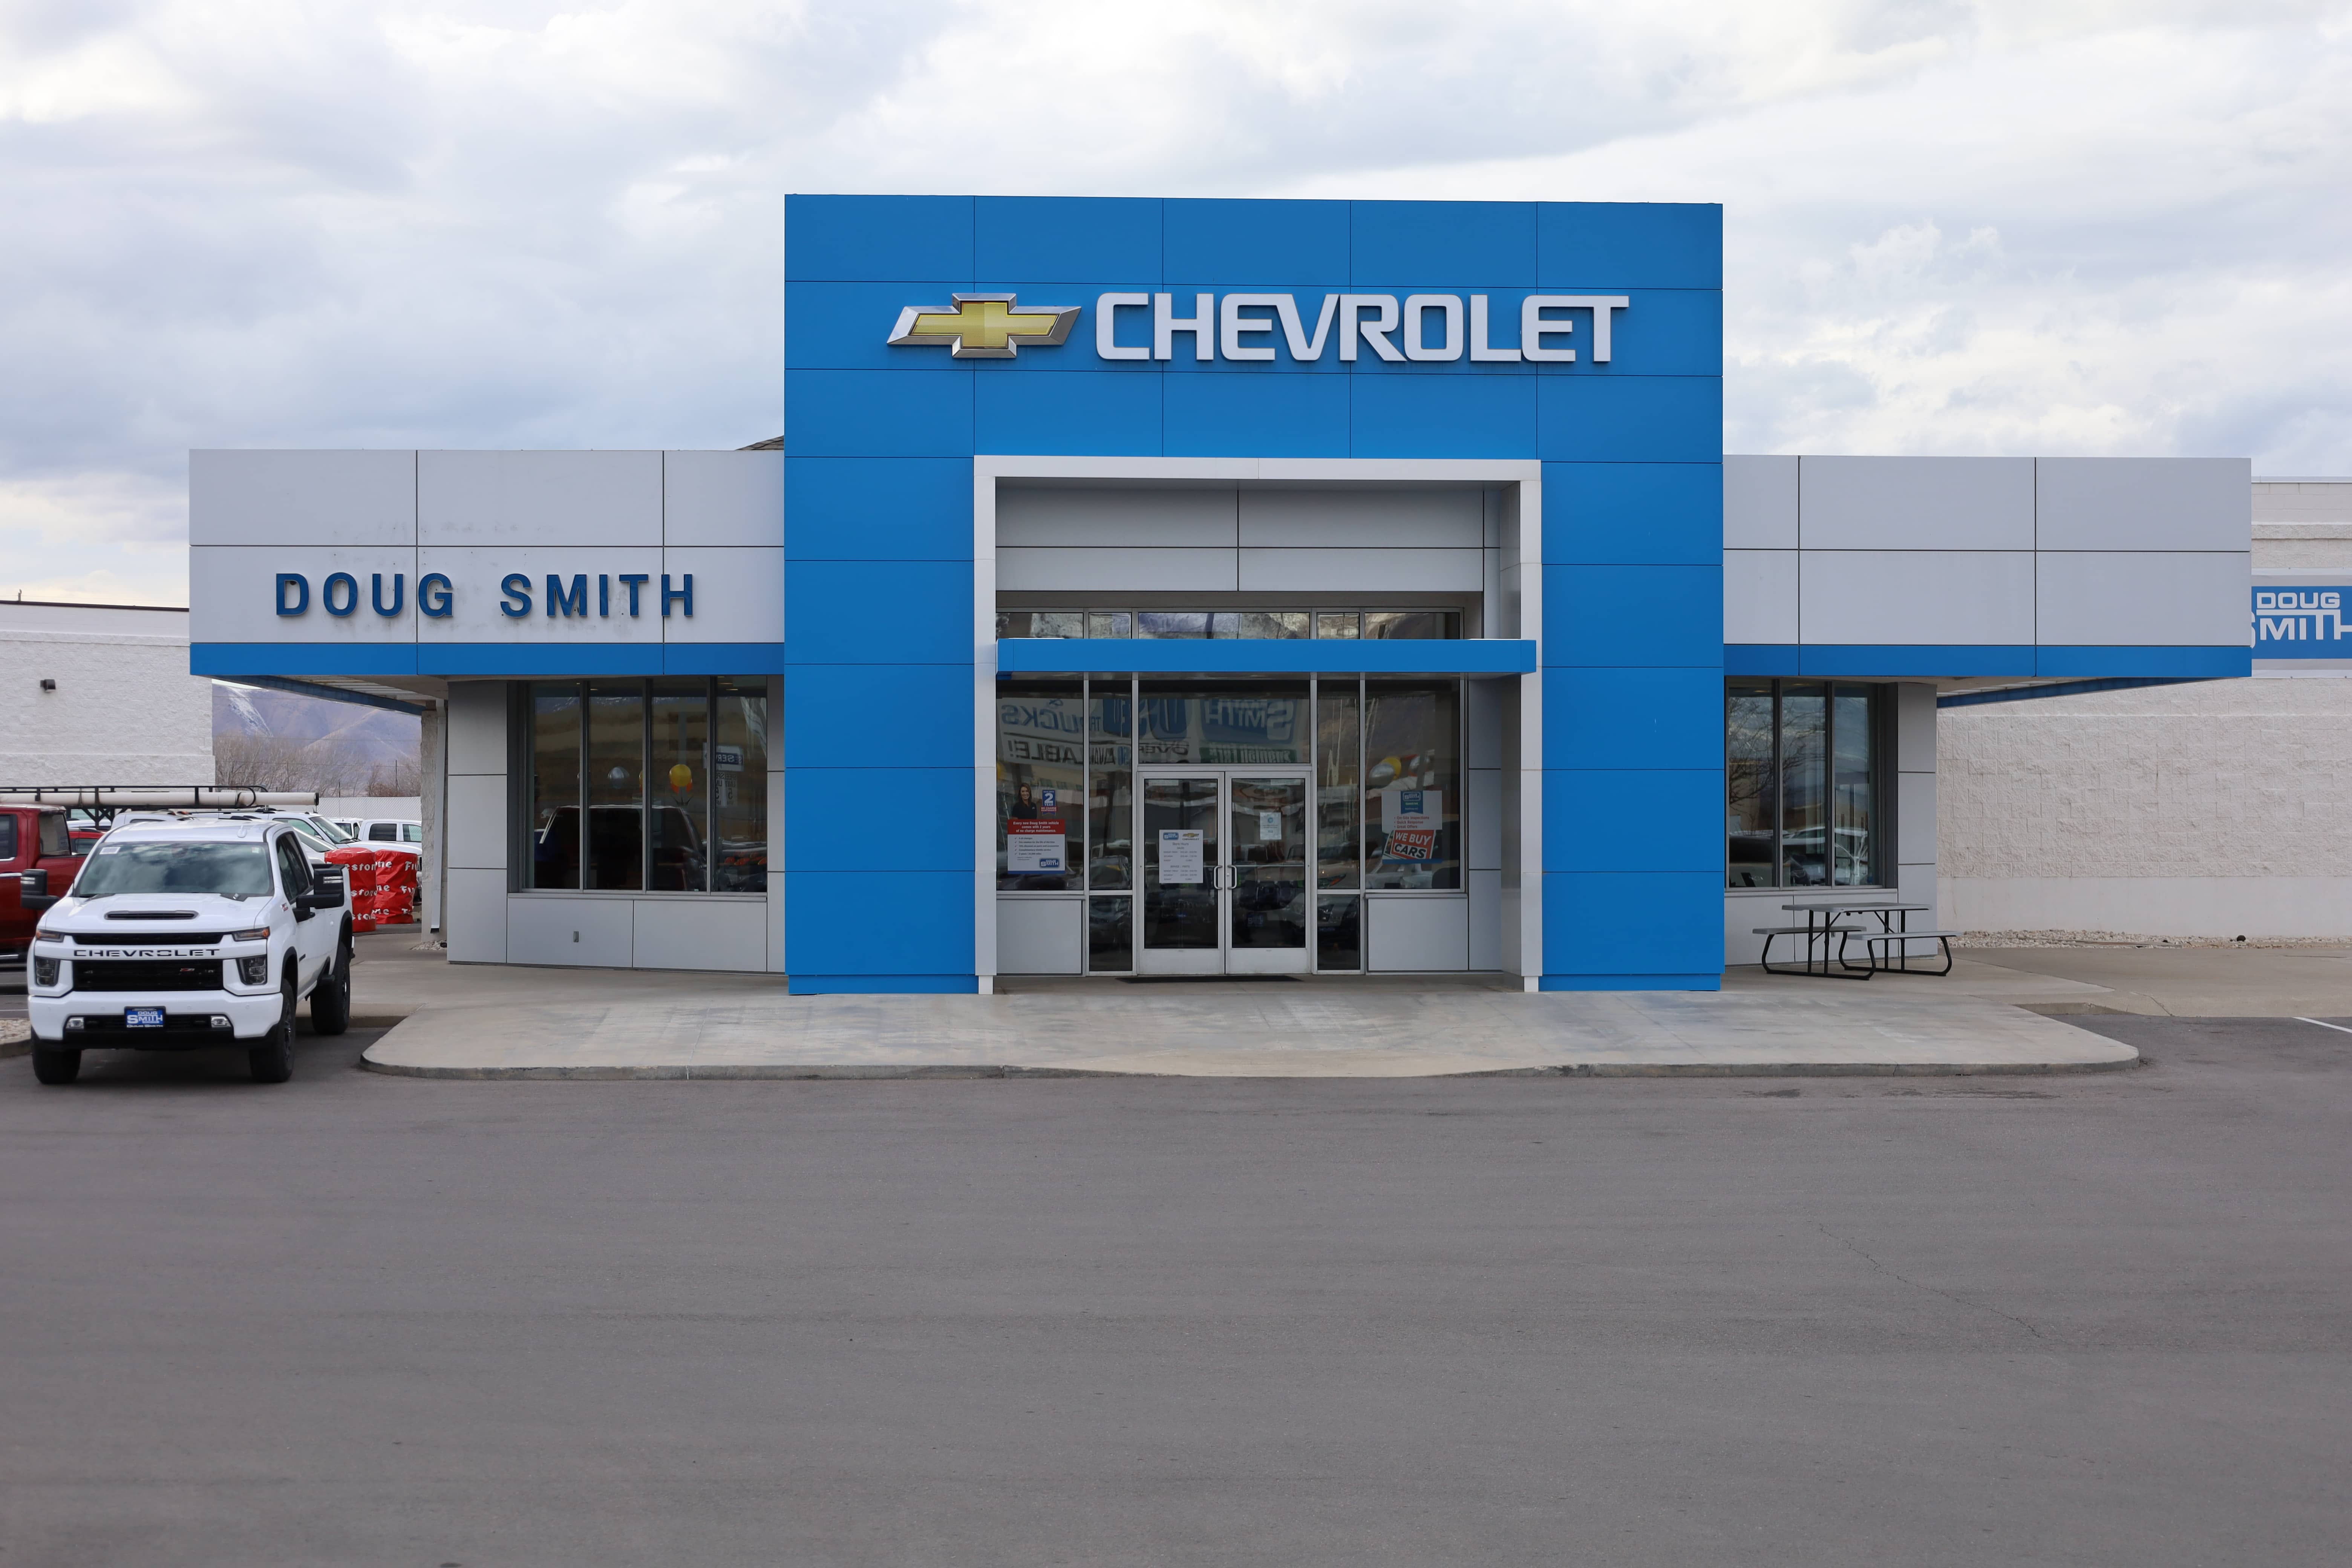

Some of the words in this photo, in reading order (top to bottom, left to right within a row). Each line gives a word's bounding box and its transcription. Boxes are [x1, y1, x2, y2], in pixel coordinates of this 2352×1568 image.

[1096, 292, 1629, 362] CHEVROLET
[276, 572, 453, 617] DOUG
[500, 573, 693, 617] SMITH
[2257, 592, 2340, 608] DOUG
[2251, 609, 2352, 649] MITH
[1044, 793, 1054, 803] 2
[1396, 832, 1408, 841] WE
[1409, 834, 1432, 845] BUY
[1395, 844, 1426, 858] CARS
[127, 1014, 163, 1024] SMITH
